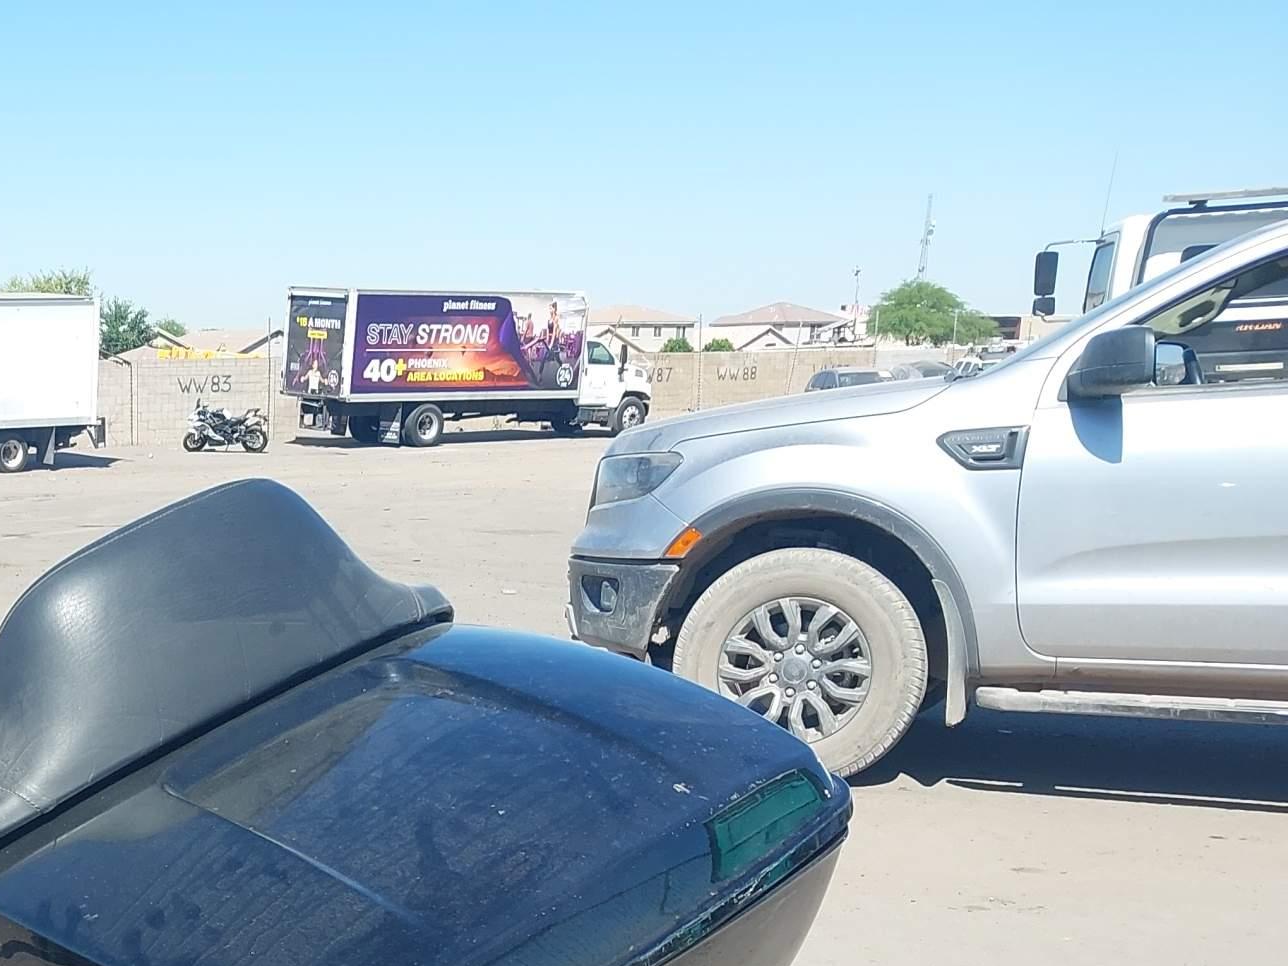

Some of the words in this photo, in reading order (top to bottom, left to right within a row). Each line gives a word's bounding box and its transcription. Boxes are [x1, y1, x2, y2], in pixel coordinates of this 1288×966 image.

[443, 299, 469, 312] planet
[470, 299, 496, 310] fitness
[308, 316, 314, 328] A
[315, 318, 341, 329] MONTH
[367, 323, 413, 345] STAY
[416, 324, 490, 345] STRONG
[408, 358, 448, 369] PHOENIX
[407, 371, 432, 382] AREA
[433, 370, 484, 381] LOCATIONS
